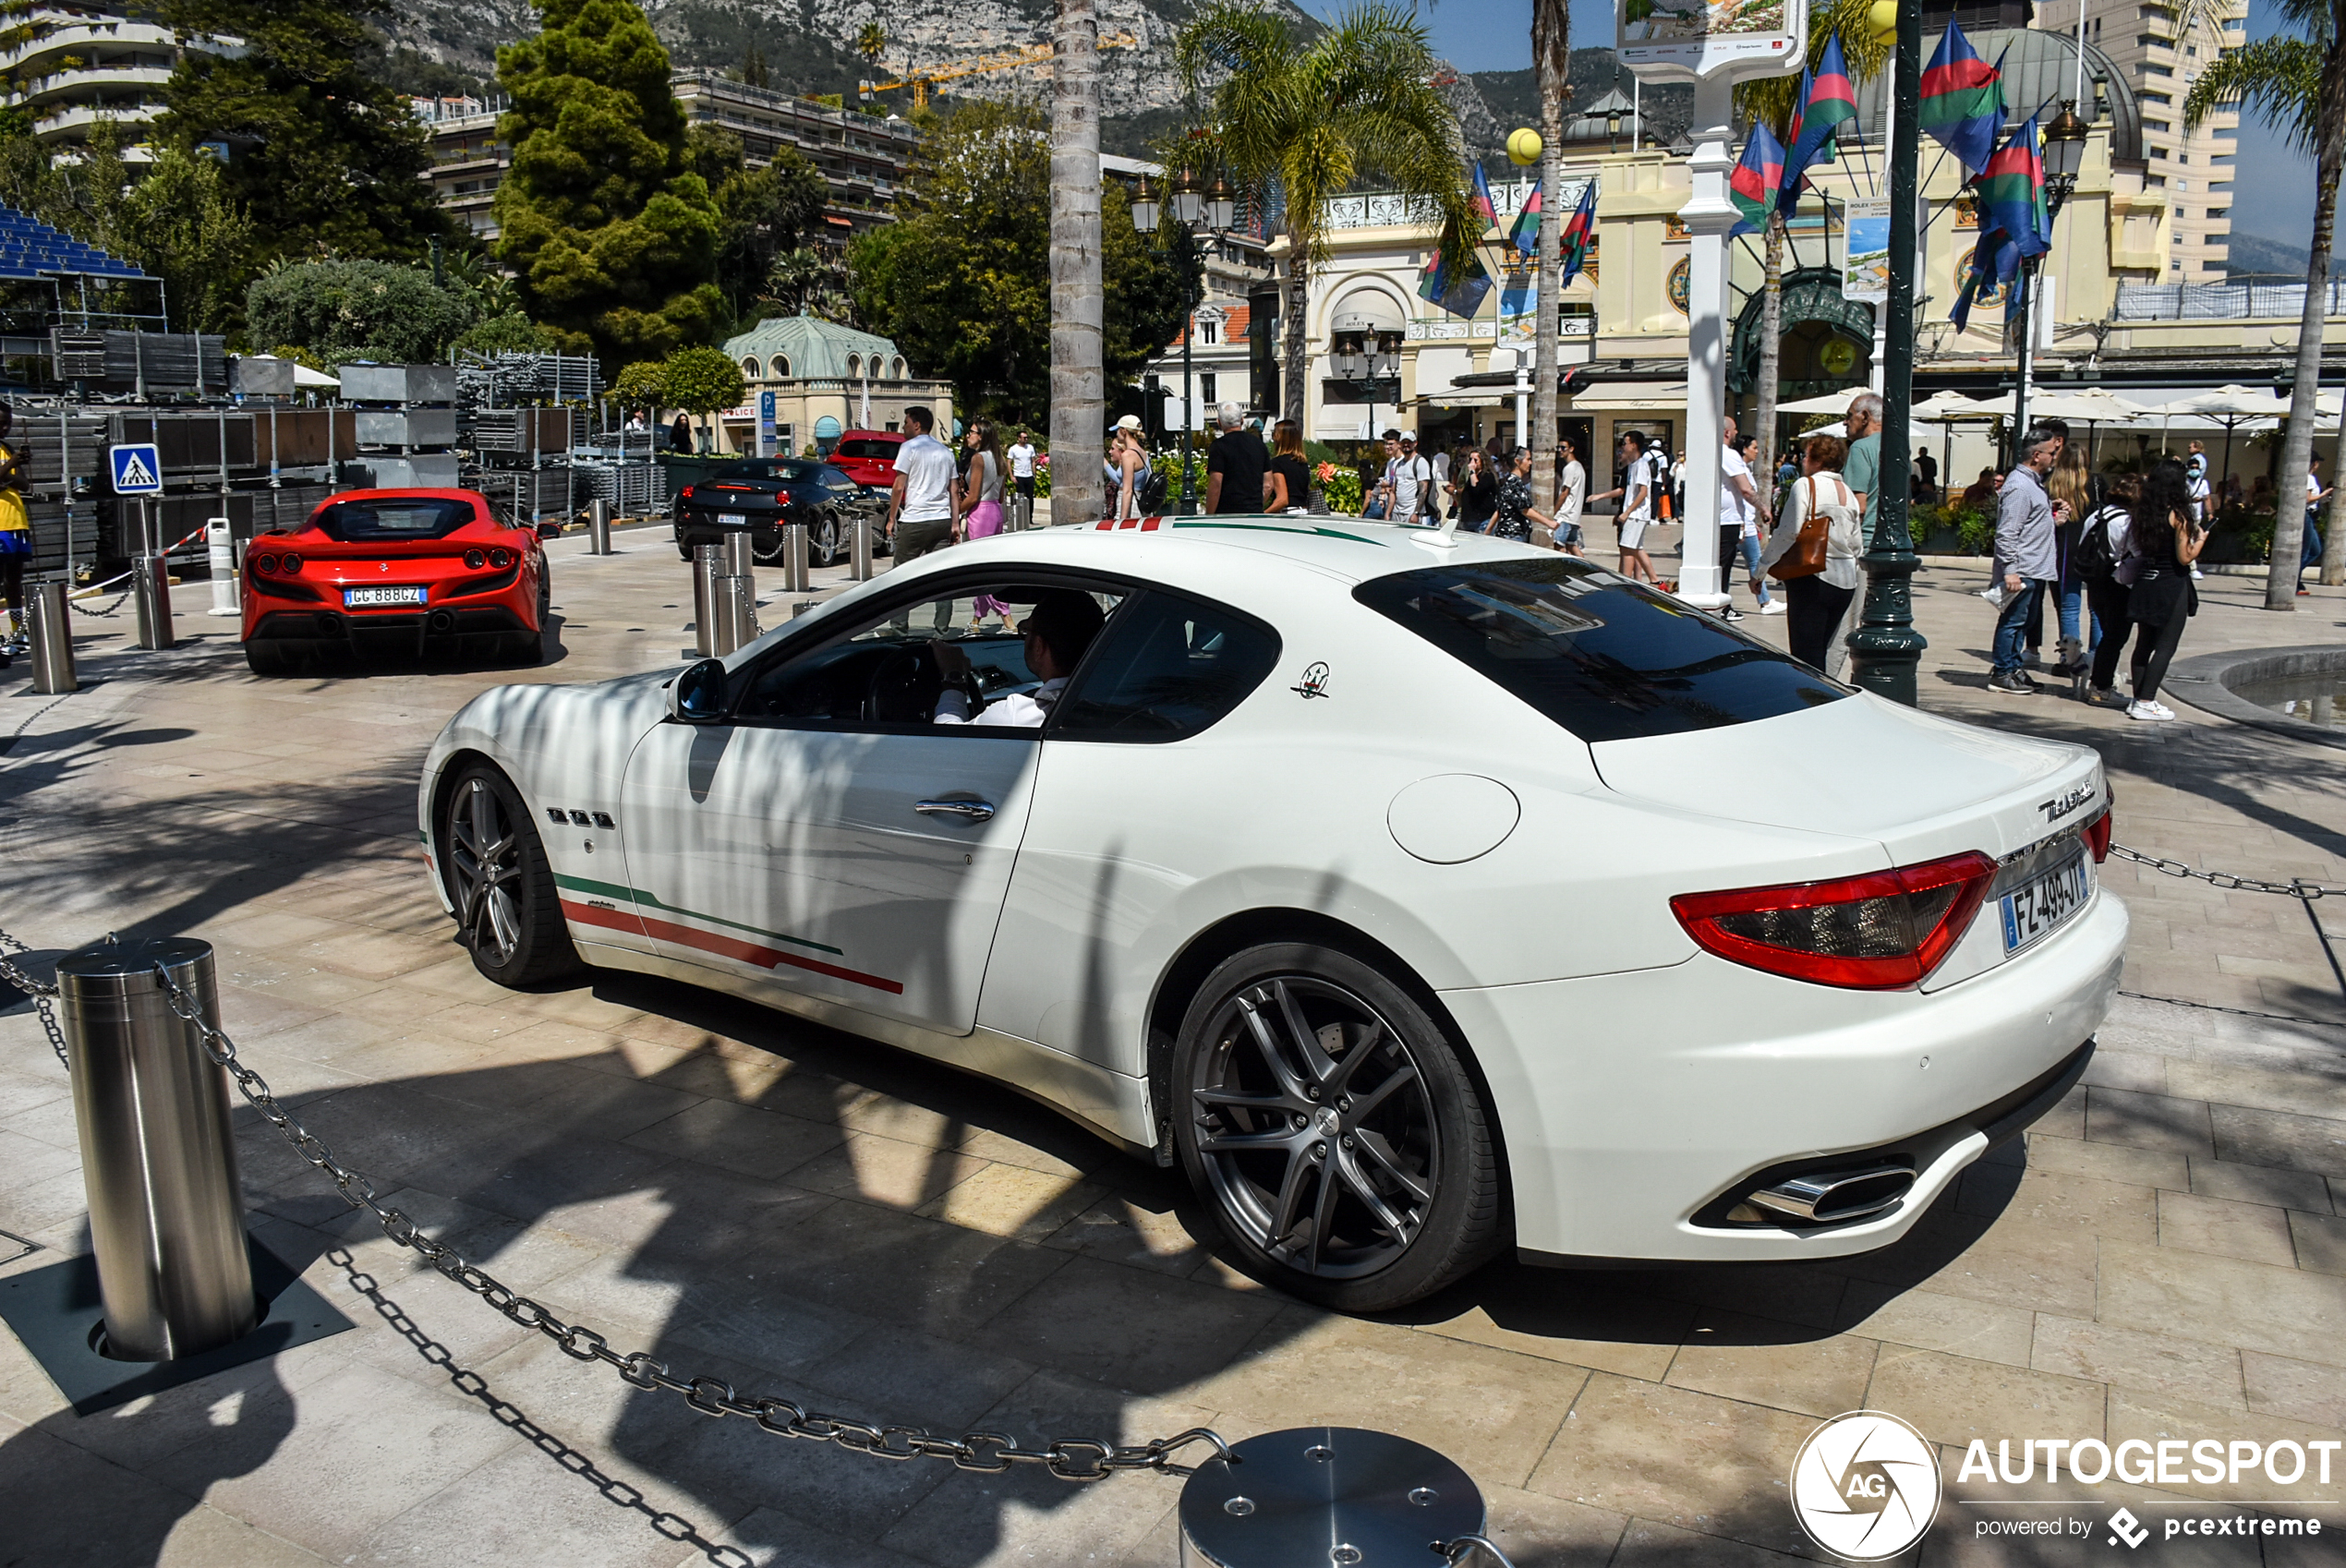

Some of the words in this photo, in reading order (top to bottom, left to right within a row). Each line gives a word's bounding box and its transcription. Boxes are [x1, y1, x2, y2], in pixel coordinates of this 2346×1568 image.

[1820, 292, 1870, 324] PARIS
[764, 394, 772, 409] P
[354, 589, 369, 602] GG
[375, 587, 417, 602] 888GZ
[2013, 862, 2081, 940] FZ-499-JT
